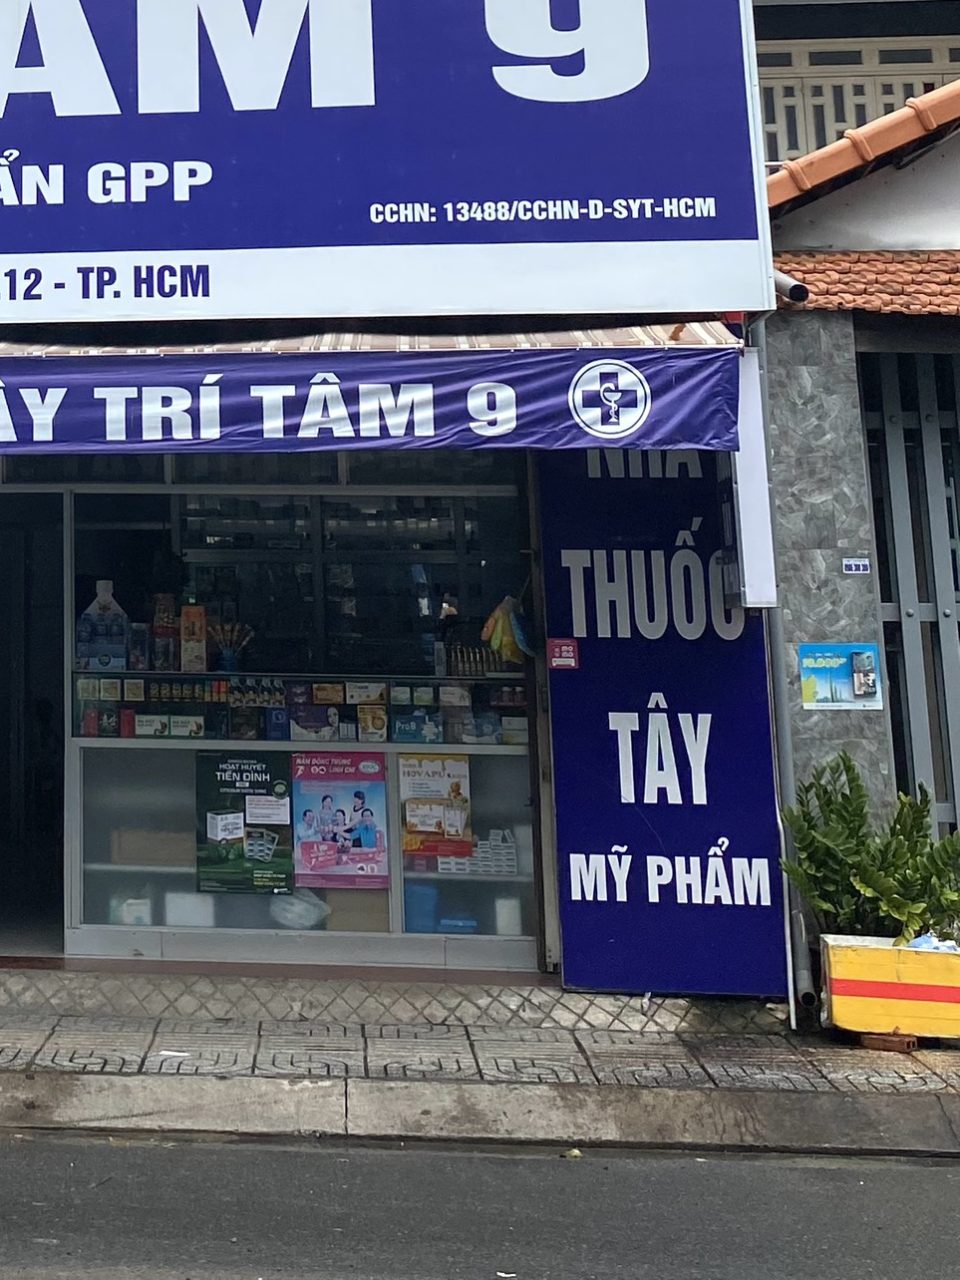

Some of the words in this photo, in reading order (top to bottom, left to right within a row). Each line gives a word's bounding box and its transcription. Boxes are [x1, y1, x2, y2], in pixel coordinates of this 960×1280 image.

[88, 161, 212, 203] GPP
[370, 203, 436, 223] CCHN:
[444, 198, 715, 221] 13488/CCHN-D-SYT-HCM
[77, 267, 120, 299] TP.
[134, 265, 209, 298] HCM
[94, 374, 221, 440] TRÍ
[251, 373, 436, 438] TÂM
[468, 382, 517, 437] 9
[609, 693, 711, 805] TÂY
[570, 845, 632, 901] MỸ
[647, 837, 771, 905] PHẨM
